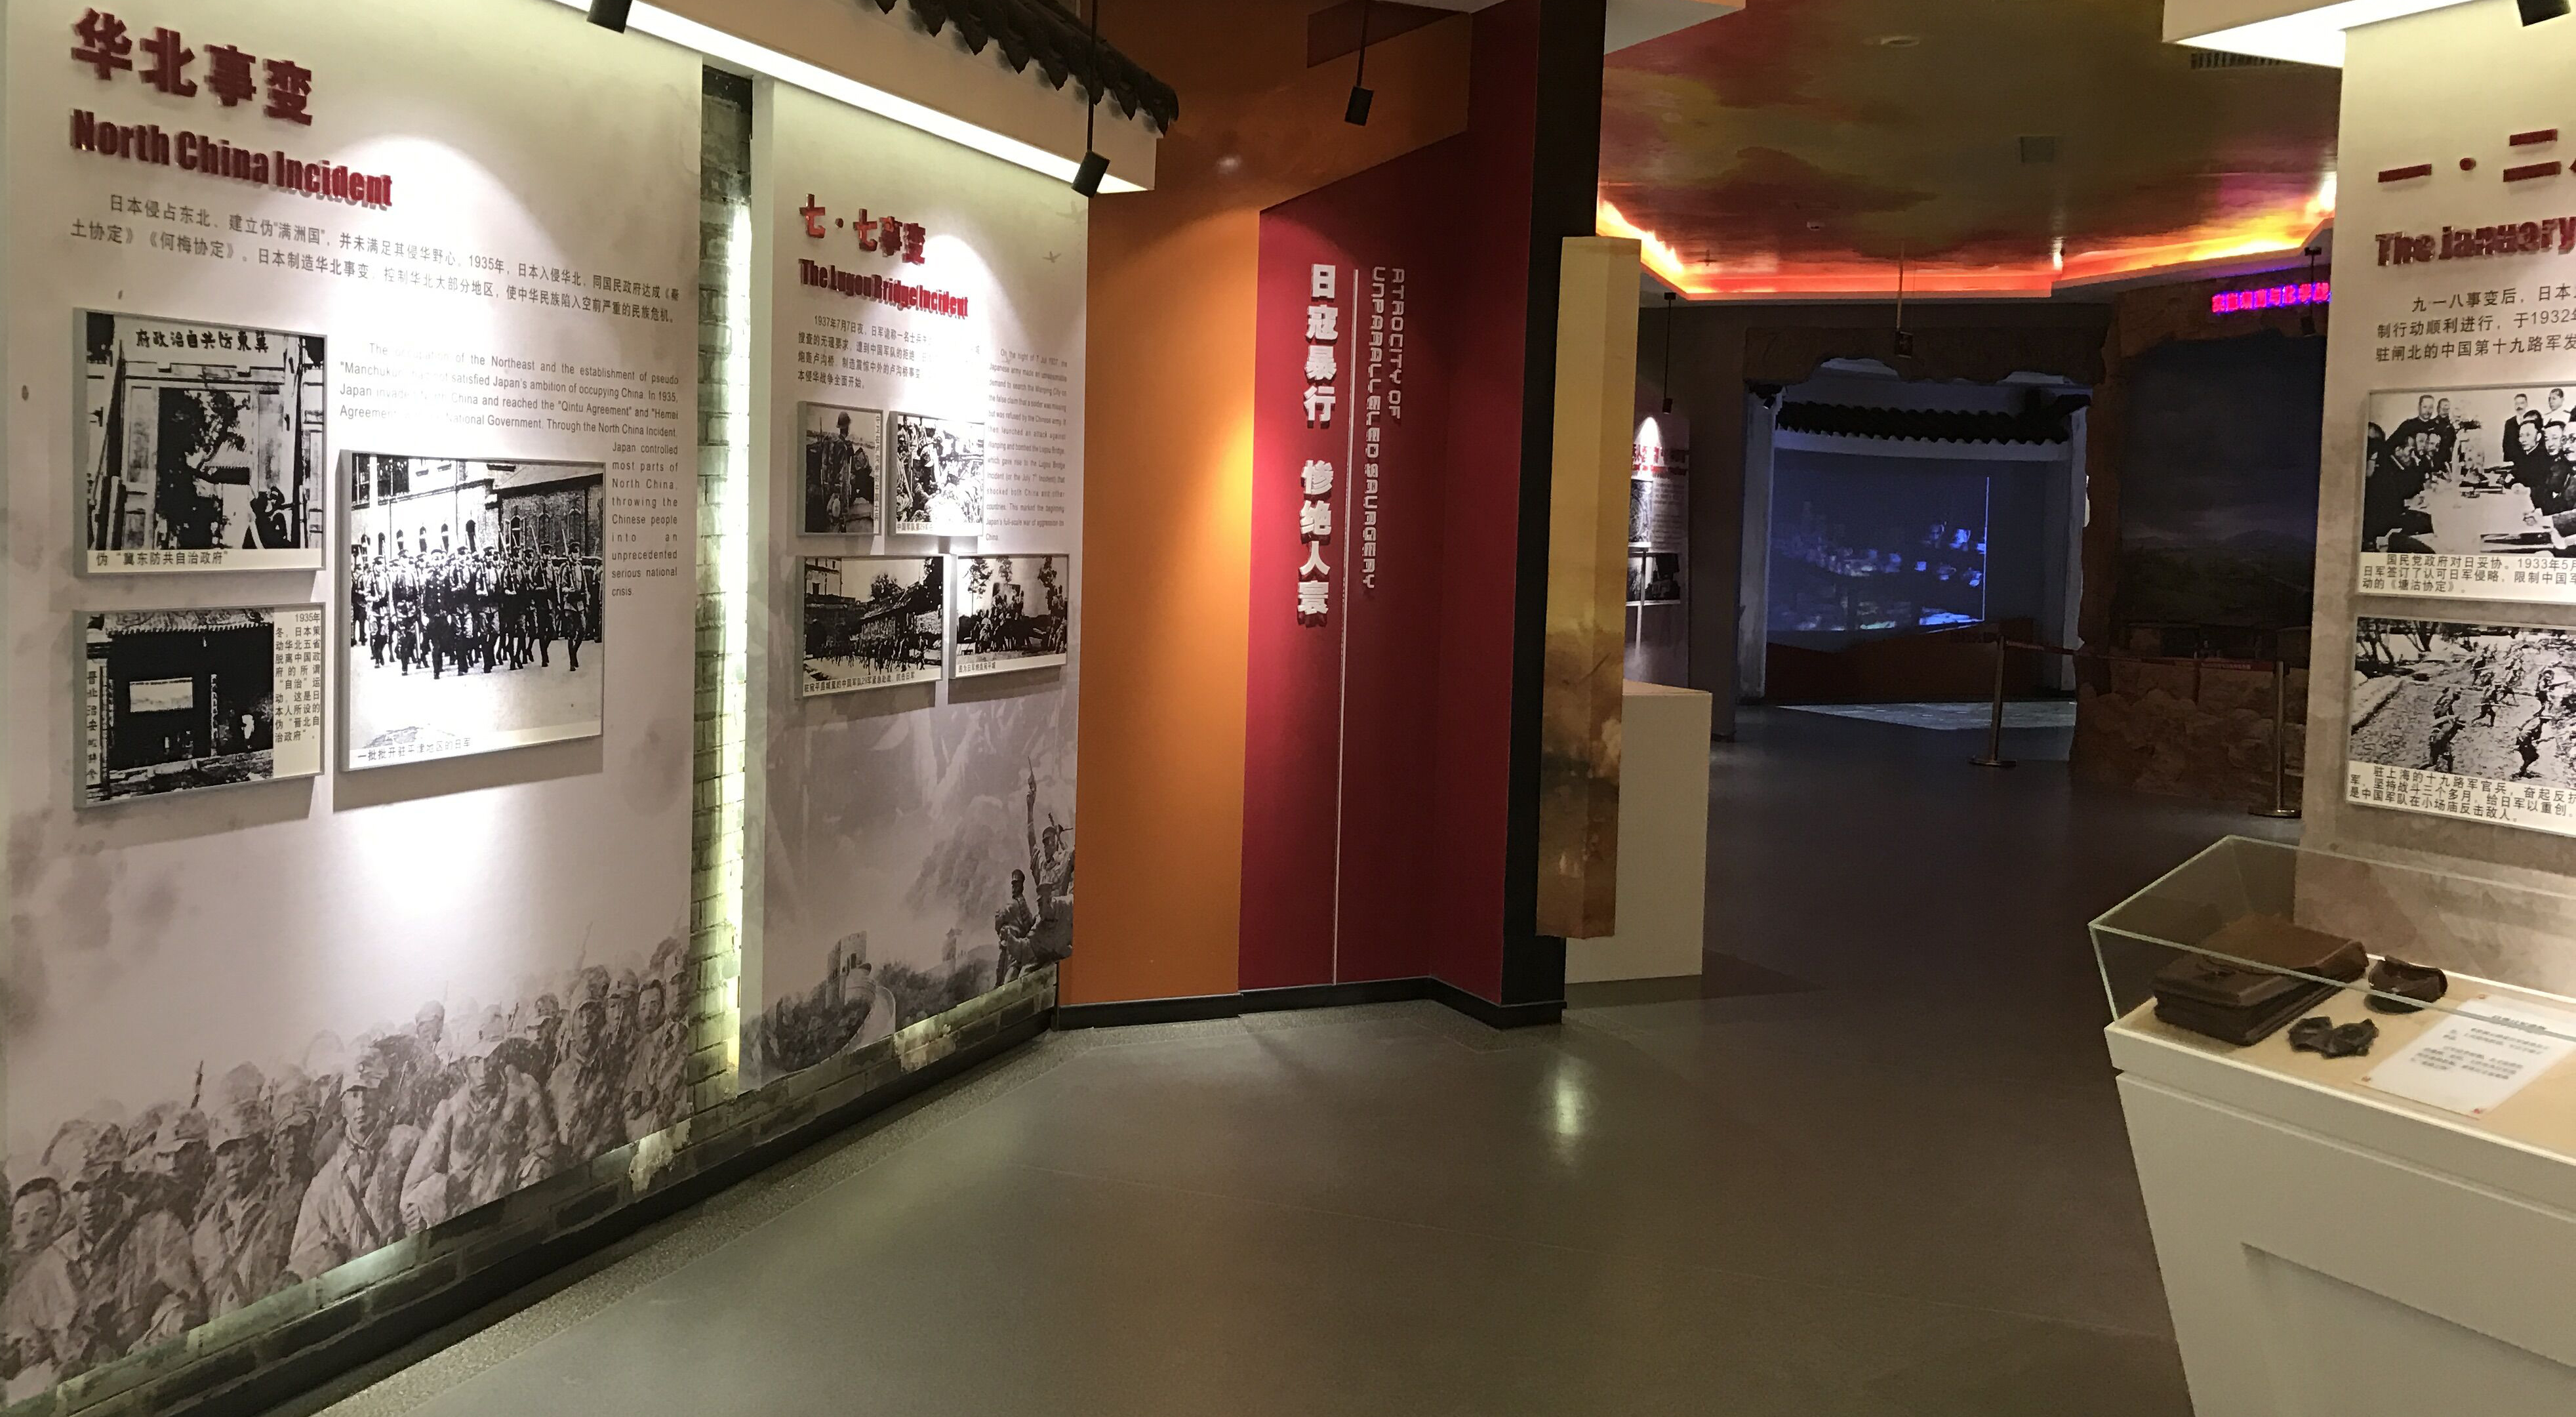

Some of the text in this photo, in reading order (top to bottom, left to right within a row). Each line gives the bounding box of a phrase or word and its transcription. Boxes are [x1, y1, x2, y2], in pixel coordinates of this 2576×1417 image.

[71, 8, 313, 125] 华北事变
[70, 108, 393, 207] North China Incident
[2377, 129, 2576, 183] 一·二
[2375, 232, 2436, 266] The
[798, 258, 828, 288] The
[917, 285, 969, 317] Incident
[1388, 268, 1405, 420] ATROCITY OF
[369, 342, 388, 356] The
[455, 352, 465, 363] of
[471, 354, 485, 365] the
[491, 356, 535, 371] Northeast
[540, 362, 556, 373] and
[561, 363, 575, 375] the
[580, 365, 635, 380] establishment
[639, 371, 647, 382] of
[651, 374, 679, 384] pseudo
[340, 383, 372, 398] Japan
[376, 387, 416, 400] invade
[451, 392, 479, 405] China
[482, 396, 499, 407] and
[502, 397, 538, 410] reached
[541, 400, 555, 411] the
[634, 408, 649, 418] and
[452, 373, 490, 386] satisfied
[493, 375, 527, 390] Japan's
[530, 380, 566, 392] ambition
[568, 384, 577, 394] of
[578, 385, 619, 399] occupying
[649, 390, 655, 400] In
[339, 404, 396, 420] Agreemen
[547, 418, 580, 433] Through
[583, 421, 596, 432] the
[598, 422, 620, 434] North
[622, 423, 644, 435] China
[612, 442, 678, 455] Japan controlled
[1297, 264, 1338, 617] 日寇暴行 惨绝人寰
[612, 461, 679, 473] most parts of
[612, 478, 640, 488] North
[612, 497, 677, 508] throwing the
[612, 514, 678, 527] Chinese people
[612, 532, 678, 543] into an
[611, 549, 678, 563] unprecedented
[611, 565, 678, 579] serious national
[295, 612, 321, 623] 1935年
